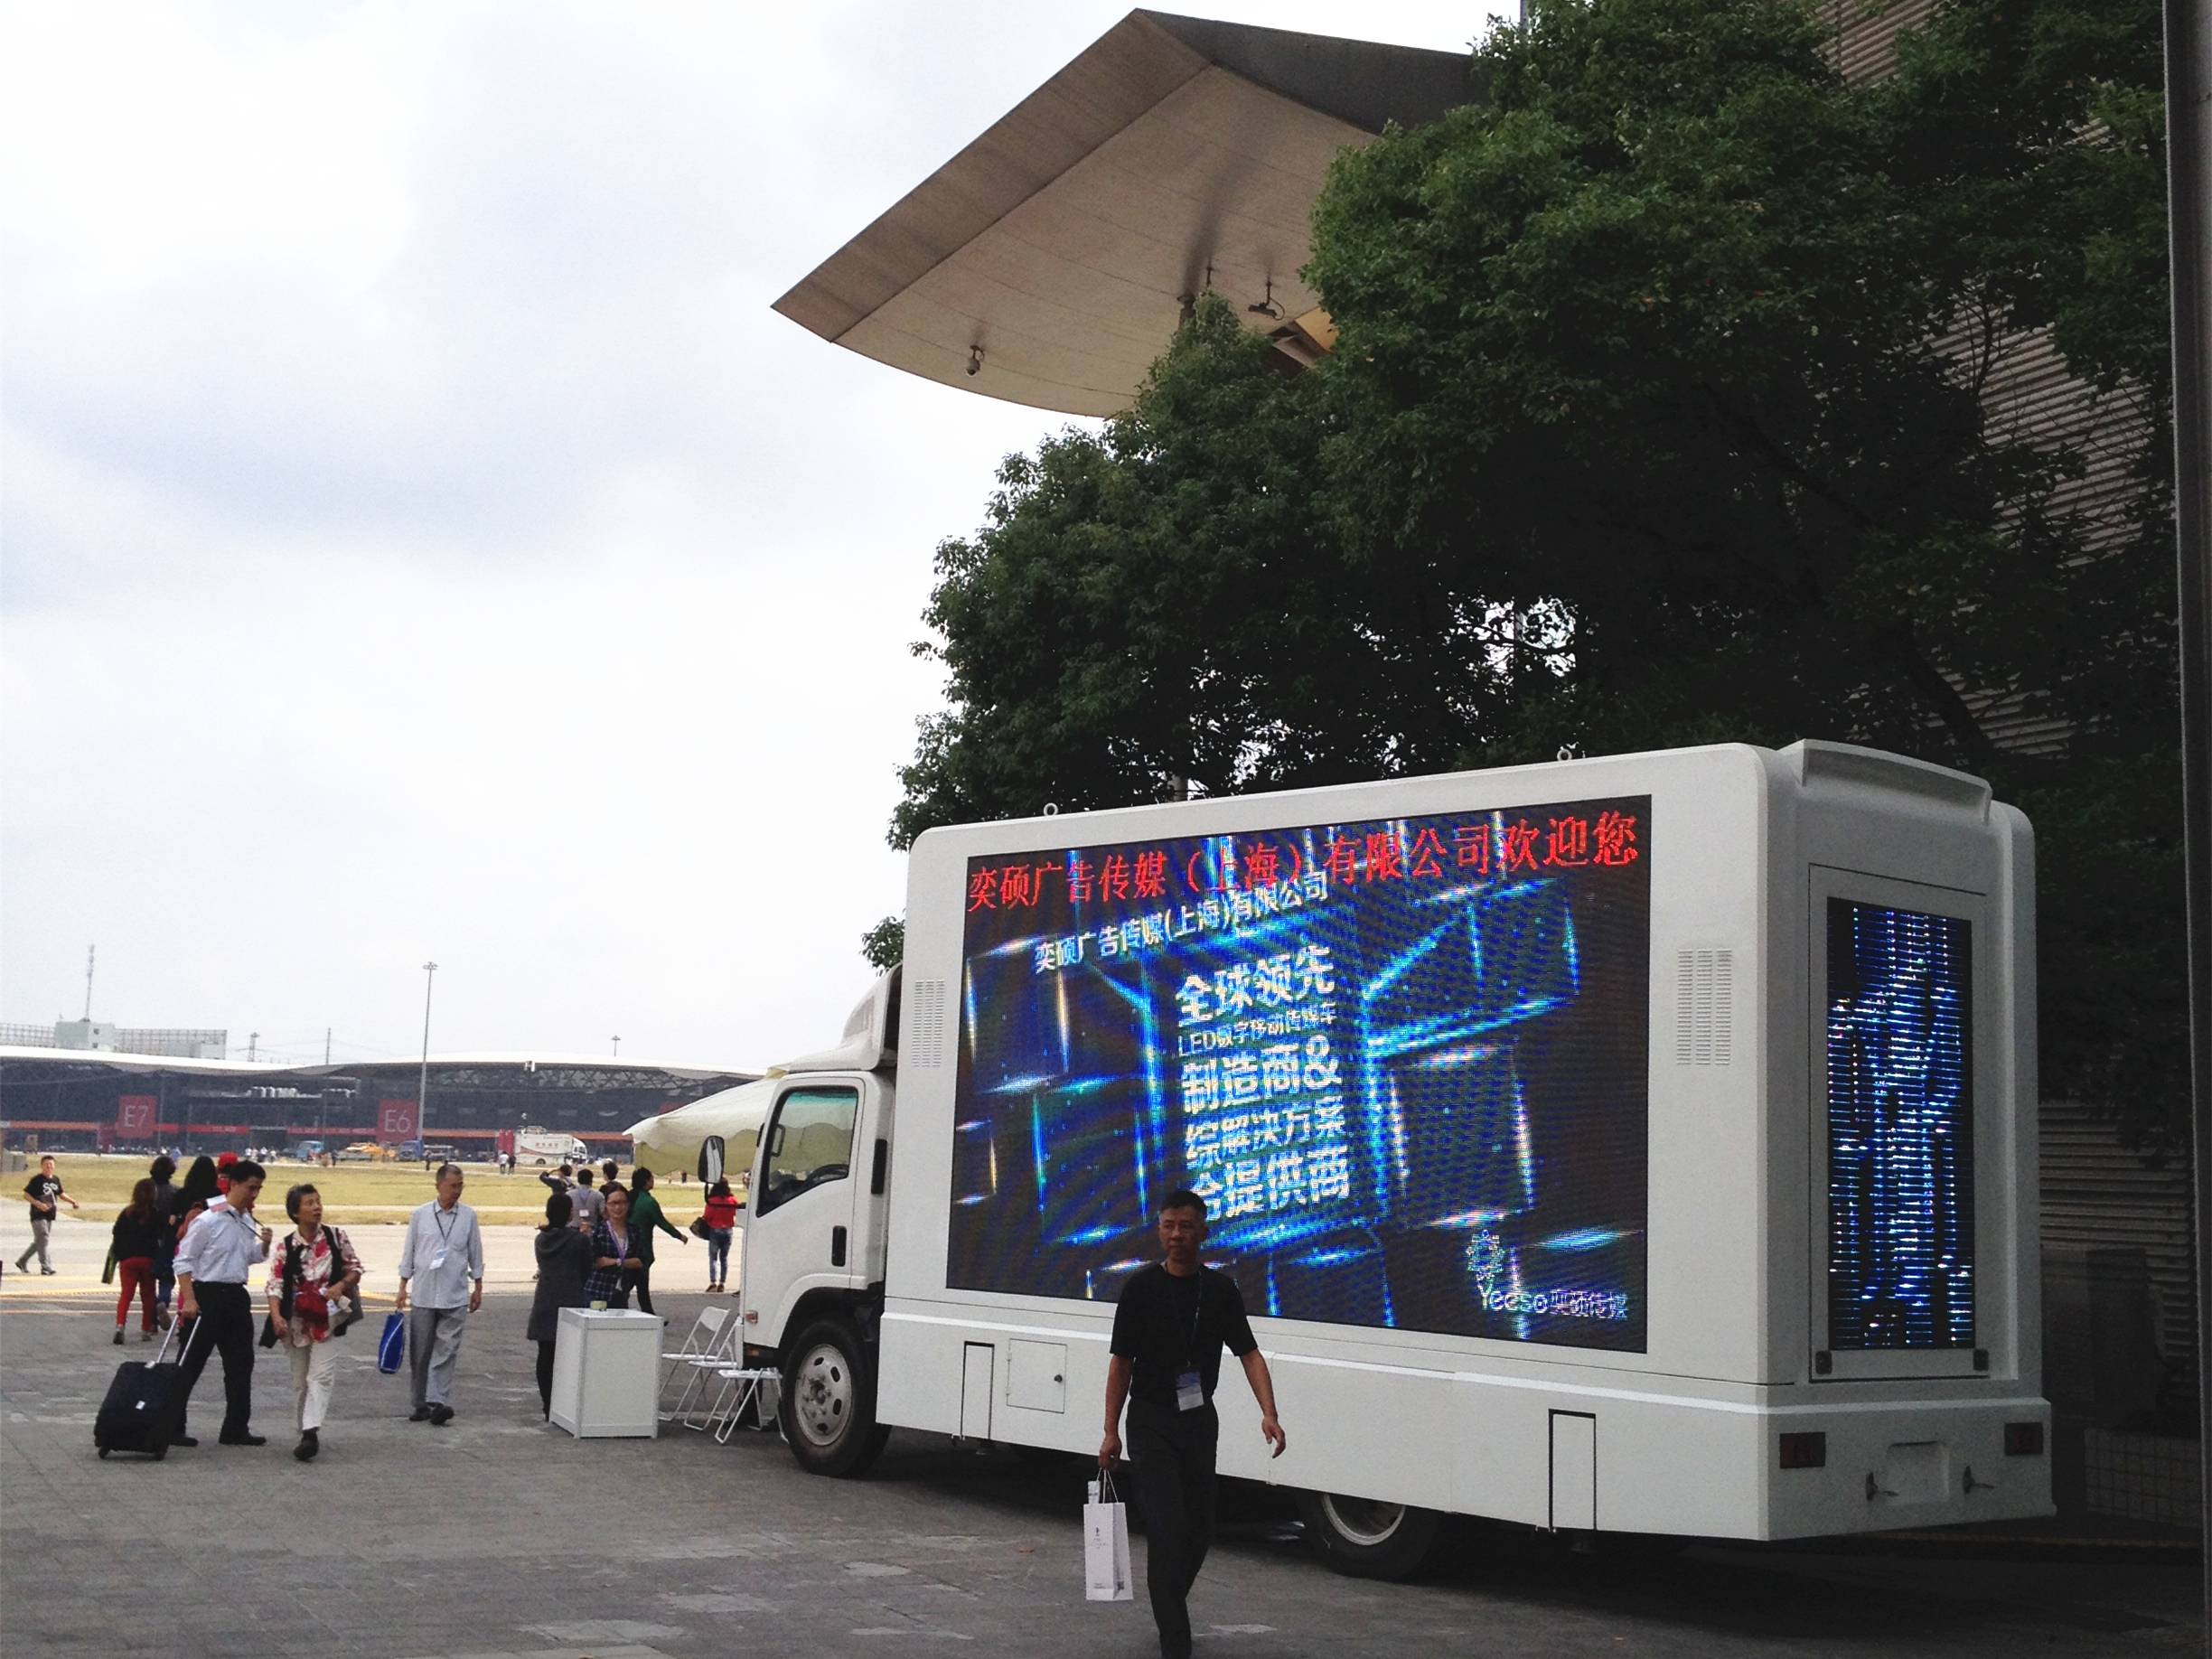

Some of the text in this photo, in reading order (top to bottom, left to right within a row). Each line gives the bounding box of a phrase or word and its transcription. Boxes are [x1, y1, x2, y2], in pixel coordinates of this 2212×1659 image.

[1176, 945, 1335, 1026] 全球领先
[125, 1105, 149, 1128] E7
[384, 1109, 411, 1133] E6
